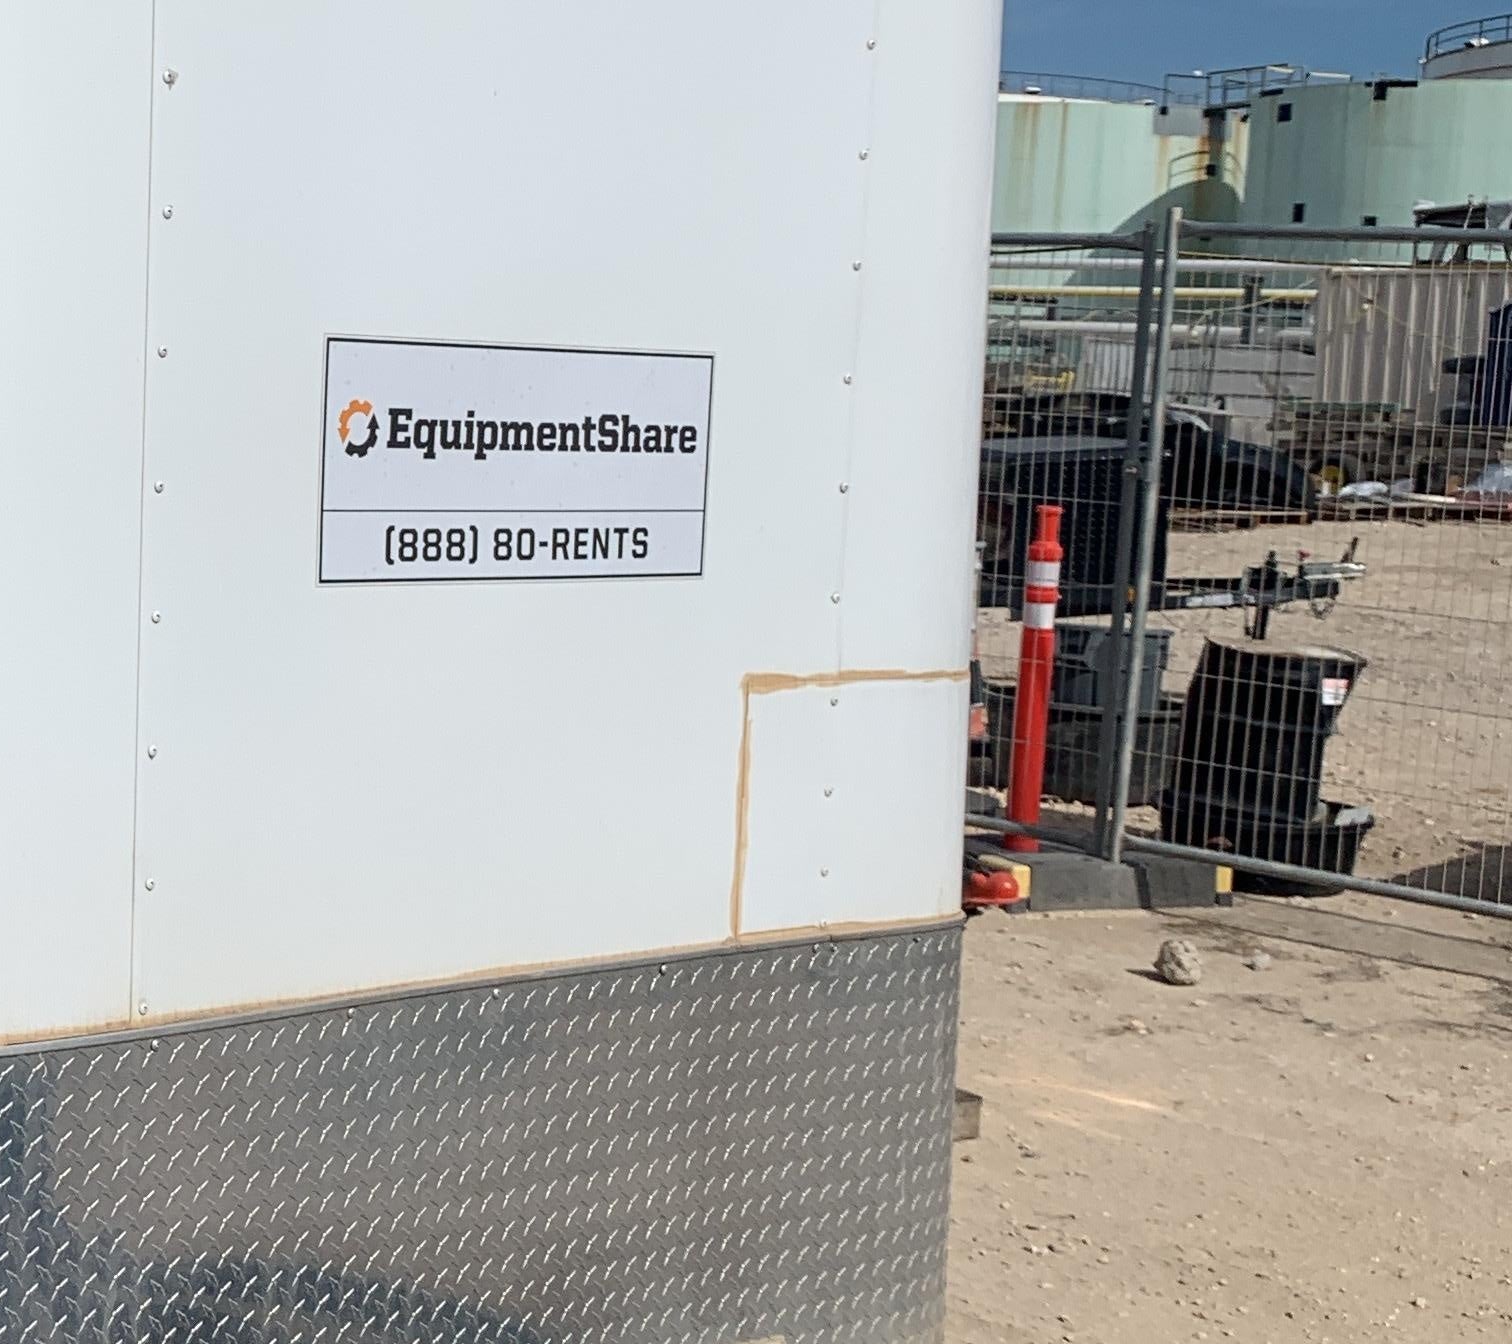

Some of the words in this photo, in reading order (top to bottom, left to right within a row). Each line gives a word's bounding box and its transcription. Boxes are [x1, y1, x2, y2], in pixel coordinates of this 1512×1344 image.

[387, 407, 698, 460] EquipmentShare
[385, 524, 479, 565] (888)
[493, 527, 649, 562] 80-RENTS
